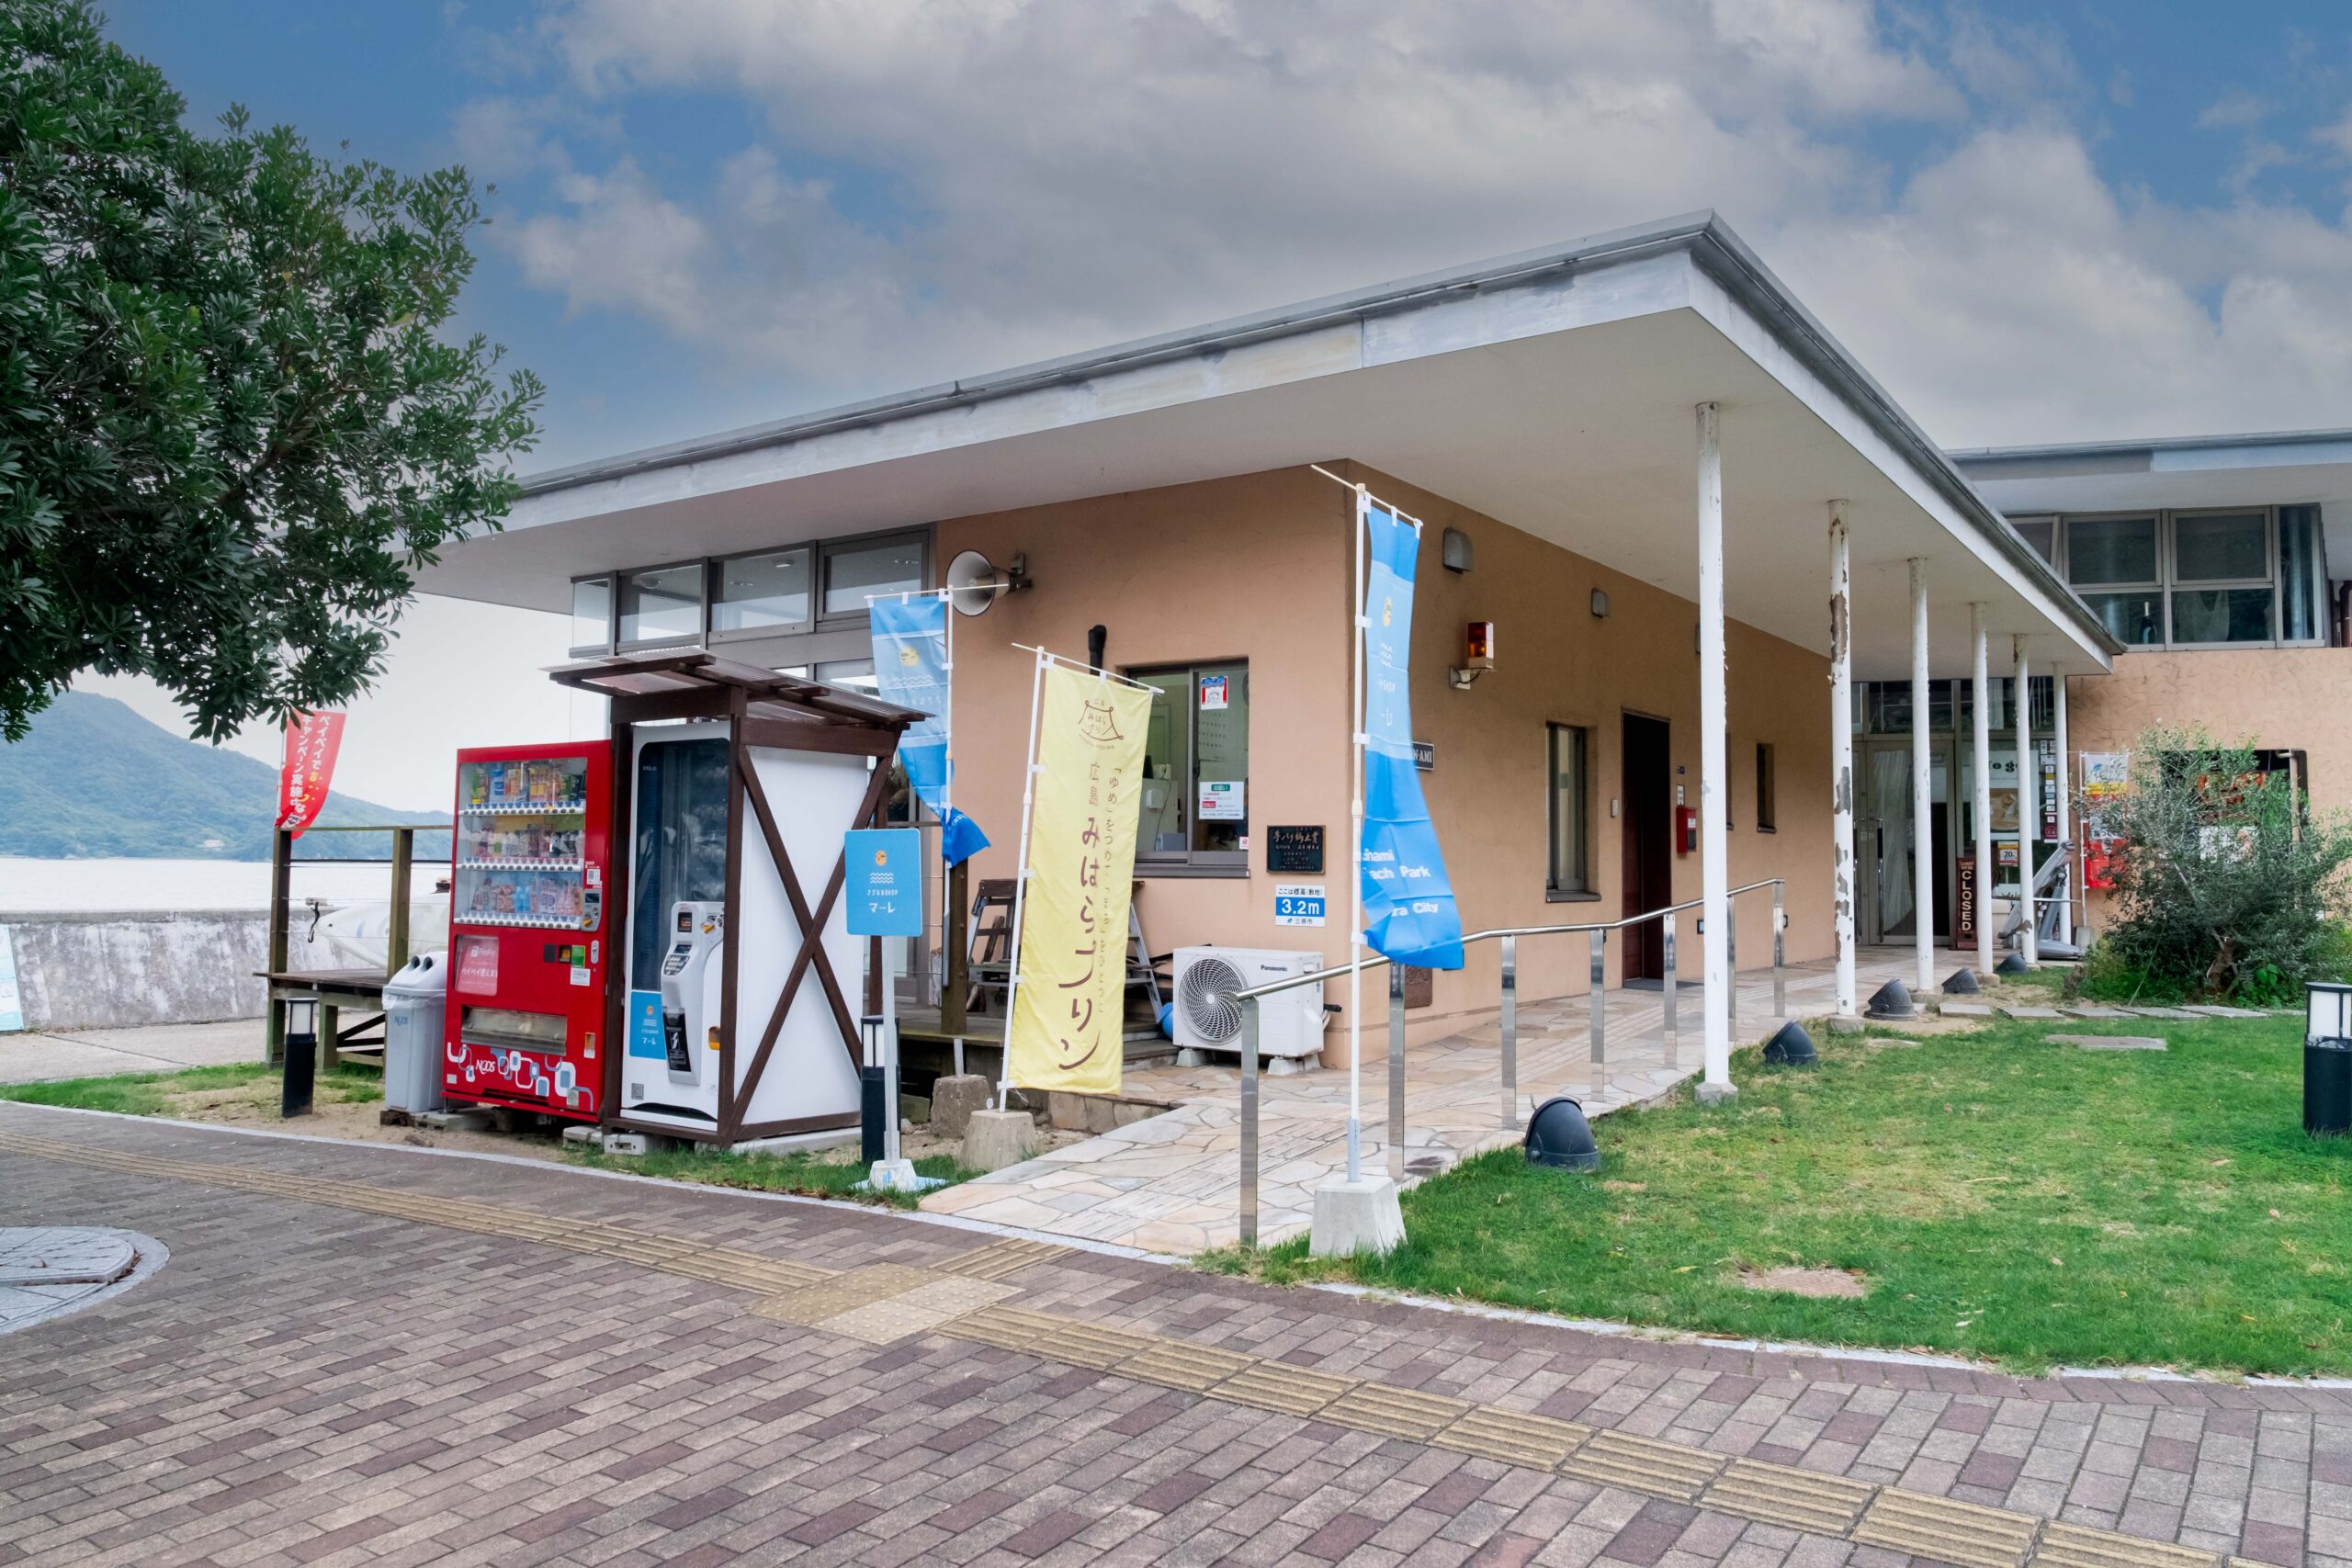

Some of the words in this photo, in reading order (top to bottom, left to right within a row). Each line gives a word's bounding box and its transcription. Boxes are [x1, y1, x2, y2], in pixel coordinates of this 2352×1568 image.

[1369, 867, 1395, 880] ach
[1399, 865, 1431, 878] Park
[868, 901, 896, 914] マーレ
[1281, 898, 1320, 915] 3.2m
[1412, 902, 1439, 914] City
[1962, 871, 1973, 931] CLOSED
[1058, 817, 1102, 1070] みはらプリン
